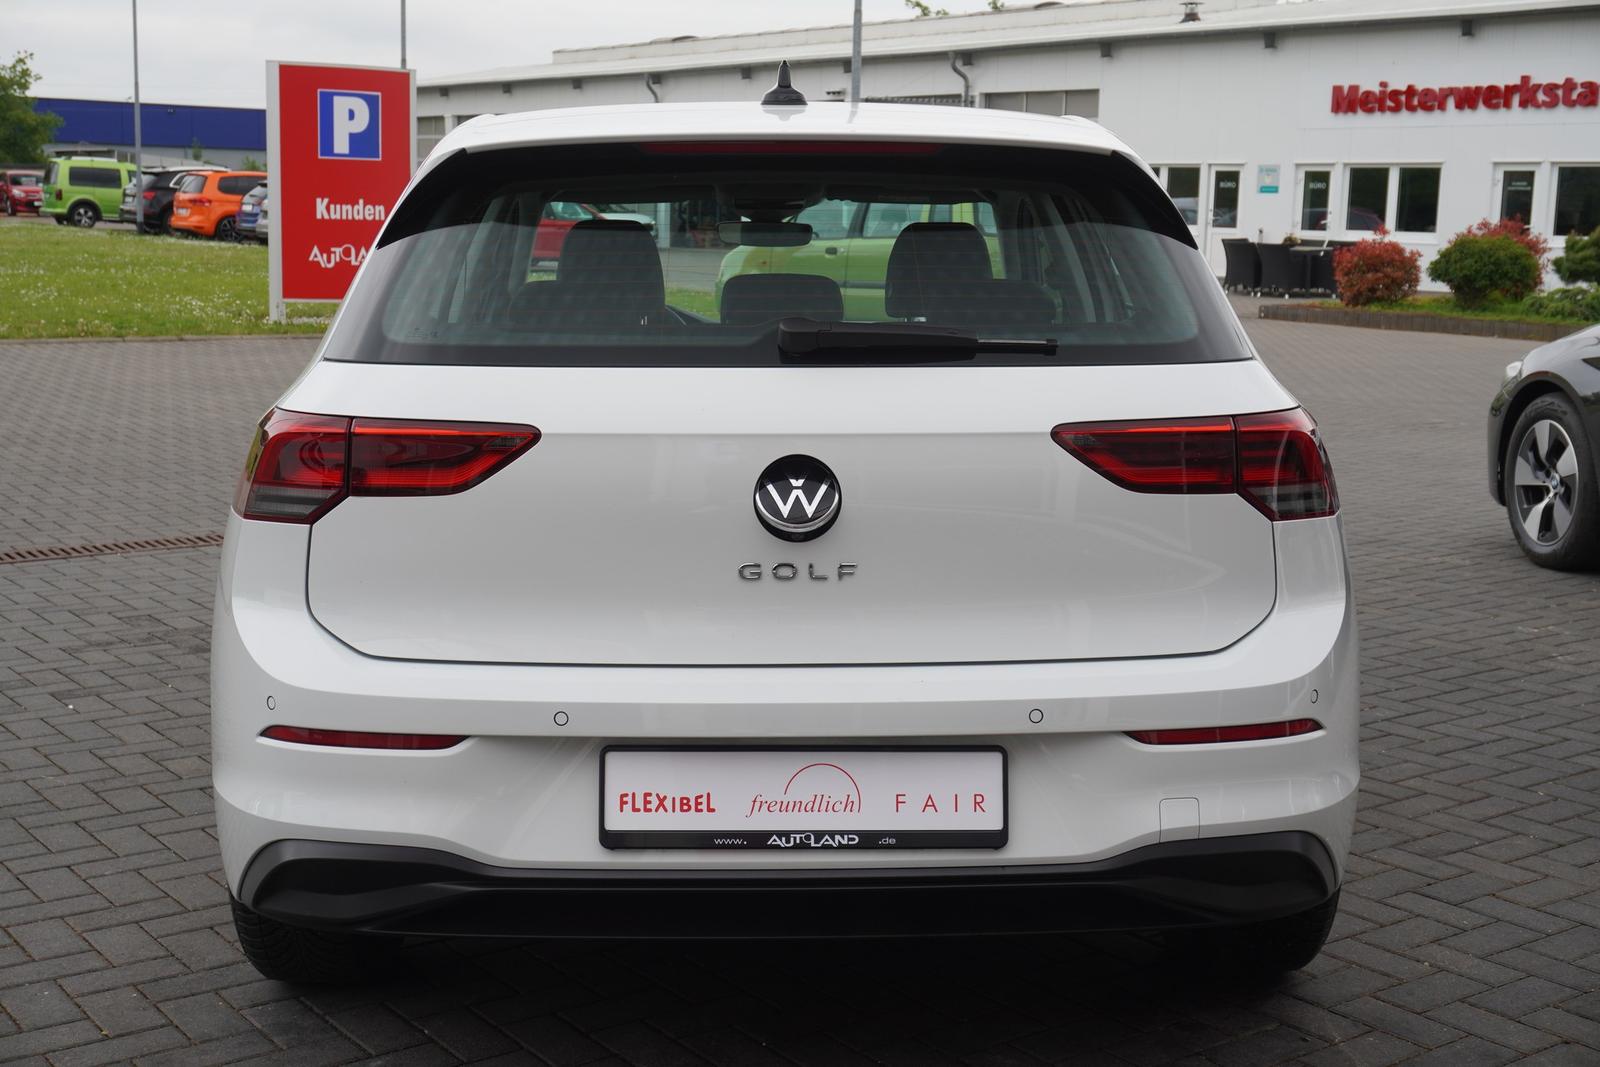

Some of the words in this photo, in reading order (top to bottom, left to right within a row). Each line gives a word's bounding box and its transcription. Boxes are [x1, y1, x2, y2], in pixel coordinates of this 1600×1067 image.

[1331, 75, 1599, 114] Meisterwerksta
[333, 95, 370, 154] P
[316, 198, 385, 221] Kunden
[738, 563, 858, 580] GOLF
[745, 794, 856, 818] freundlich
[895, 793, 986, 813] FAIR
[767, 832, 860, 847] AUTOLAND
[878, 837, 897, 845] .de
